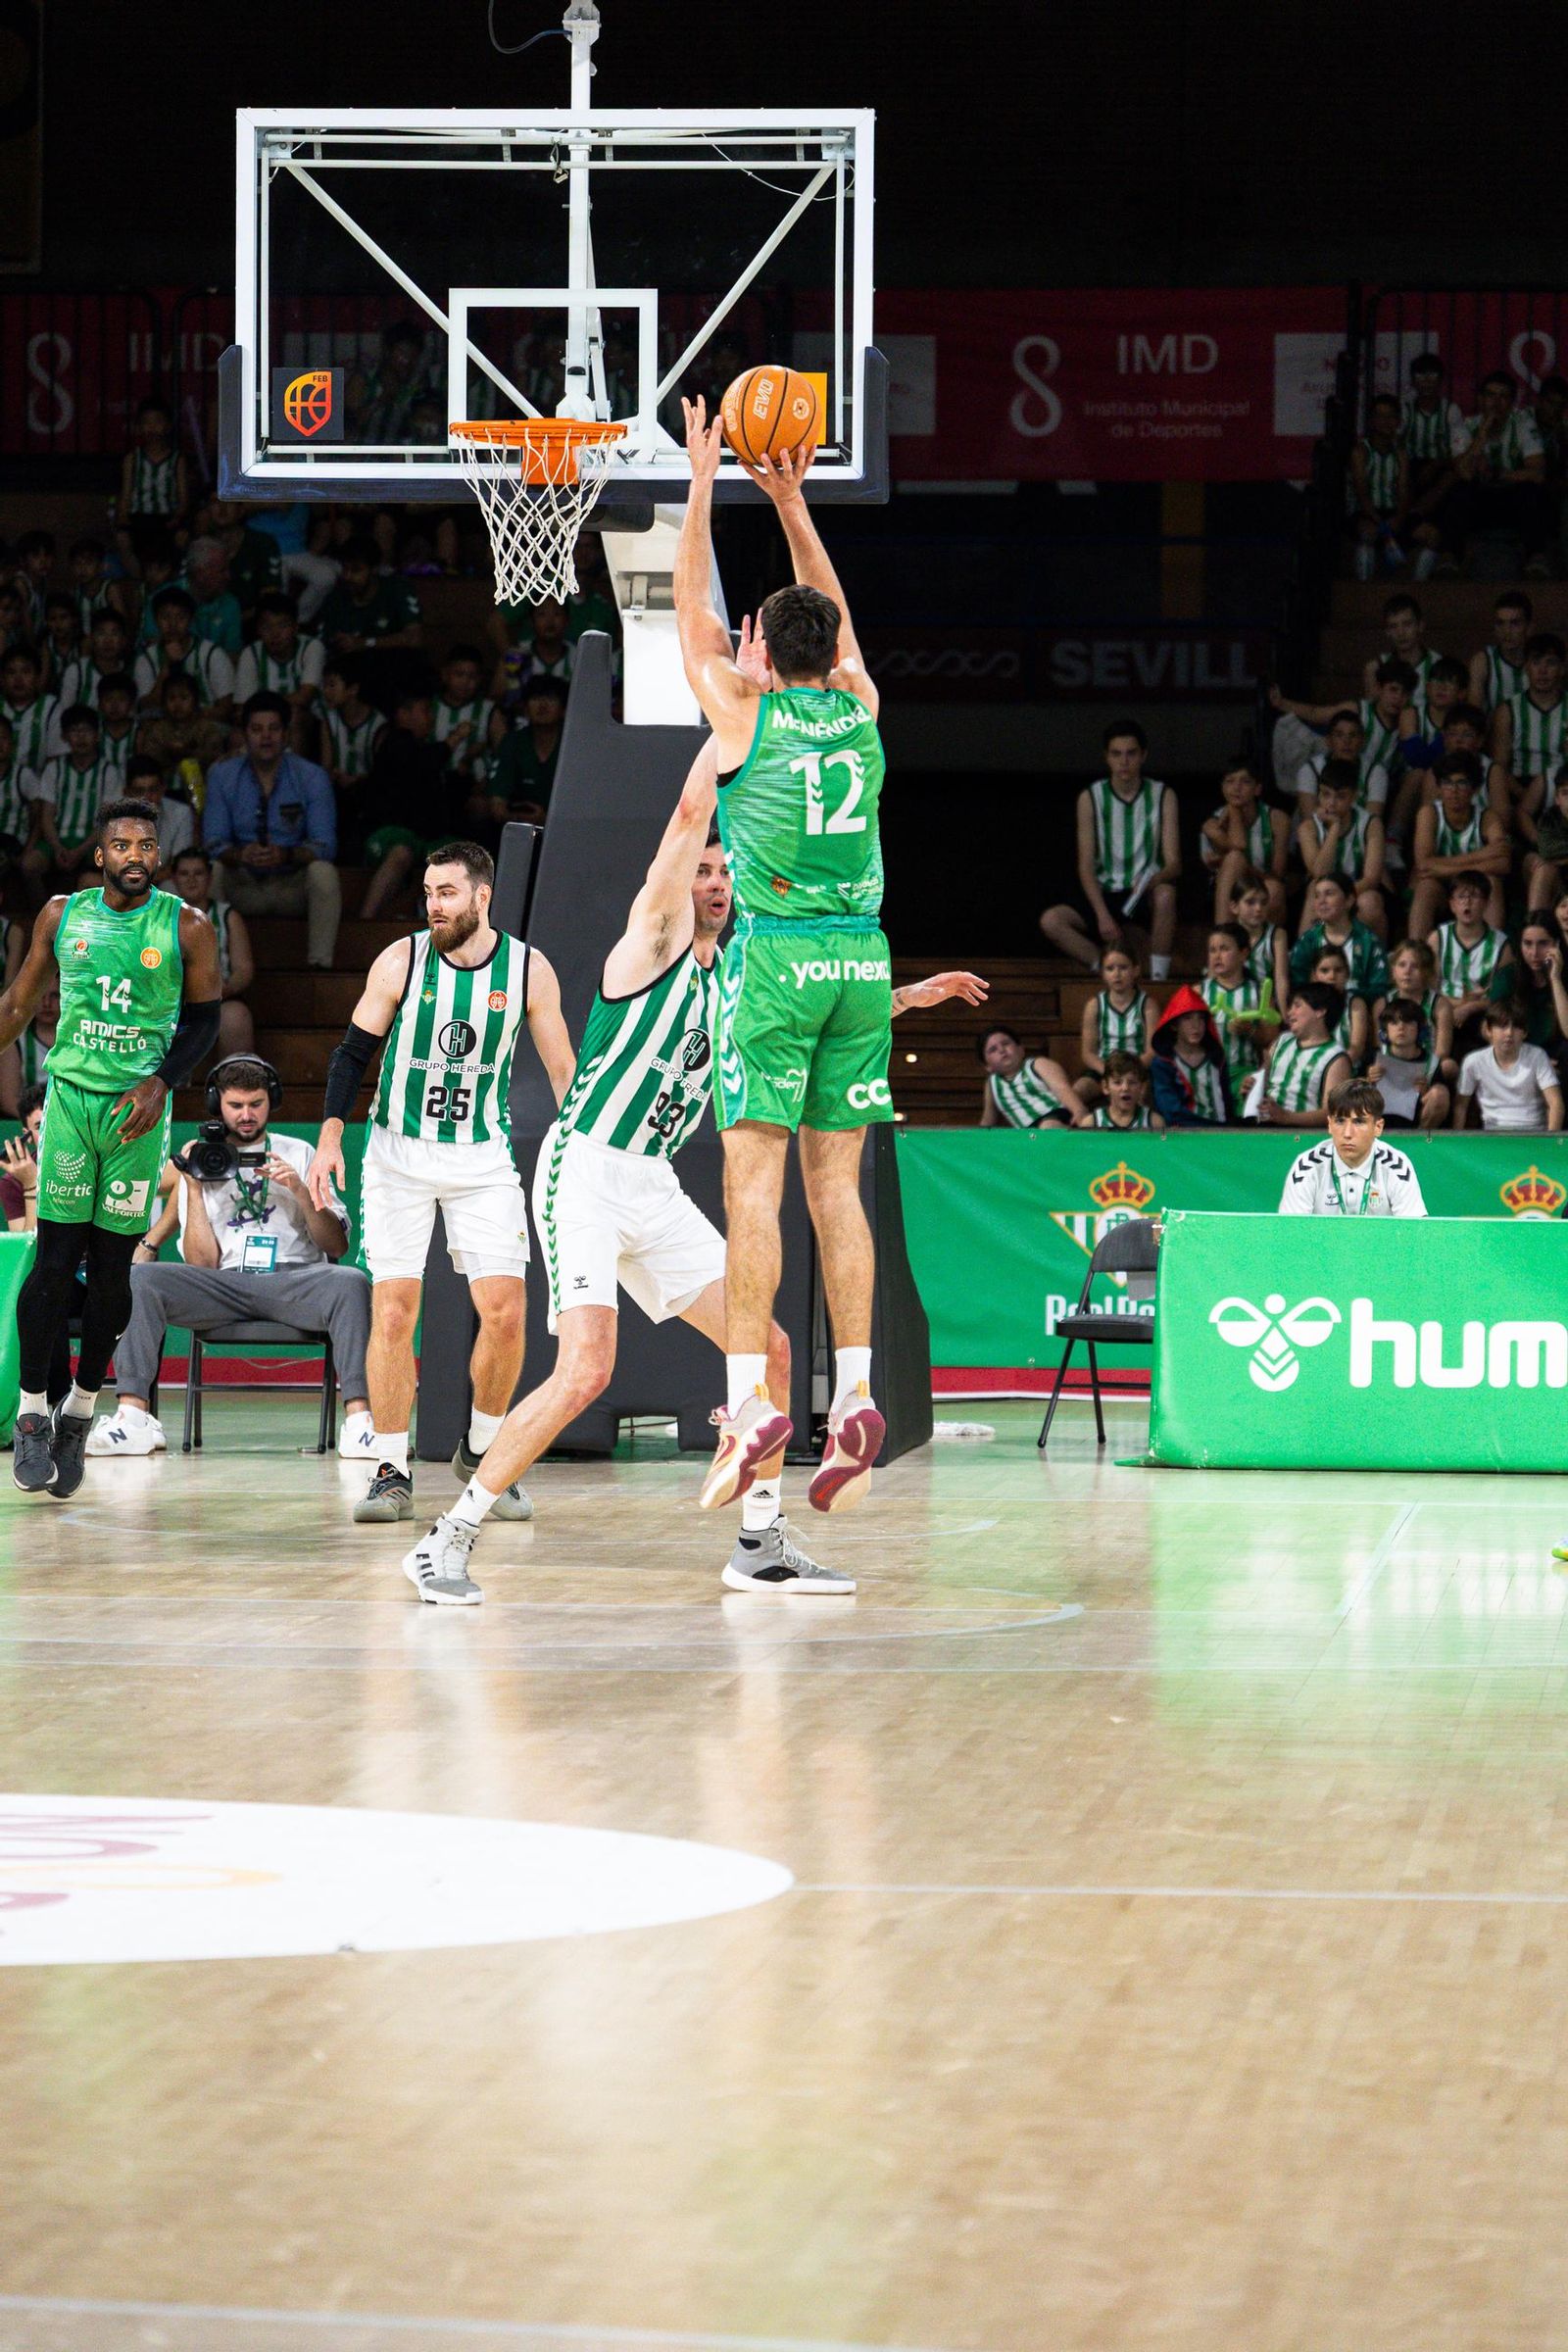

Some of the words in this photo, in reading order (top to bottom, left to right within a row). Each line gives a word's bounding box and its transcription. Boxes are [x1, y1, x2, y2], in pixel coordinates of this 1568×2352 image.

[1116, 333, 1219, 375] IMD
[753, 378, 774, 419] EVO
[1162, 400, 1250, 420] Municipal
[789, 750, 866, 836] 12
[96, 975, 131, 1013] 14
[74, 1033, 147, 1054] CASTELLÓ
[80, 1019, 141, 1039] AMICS
[409, 1059, 448, 1071] GRUPO
[452, 1063, 494, 1073] HEREDA
[426, 1086, 470, 1122] 25
[648, 1091, 685, 1138] 93
[46, 1179, 93, 1197] ibertic
[1349, 1298, 1568, 1388] hum
